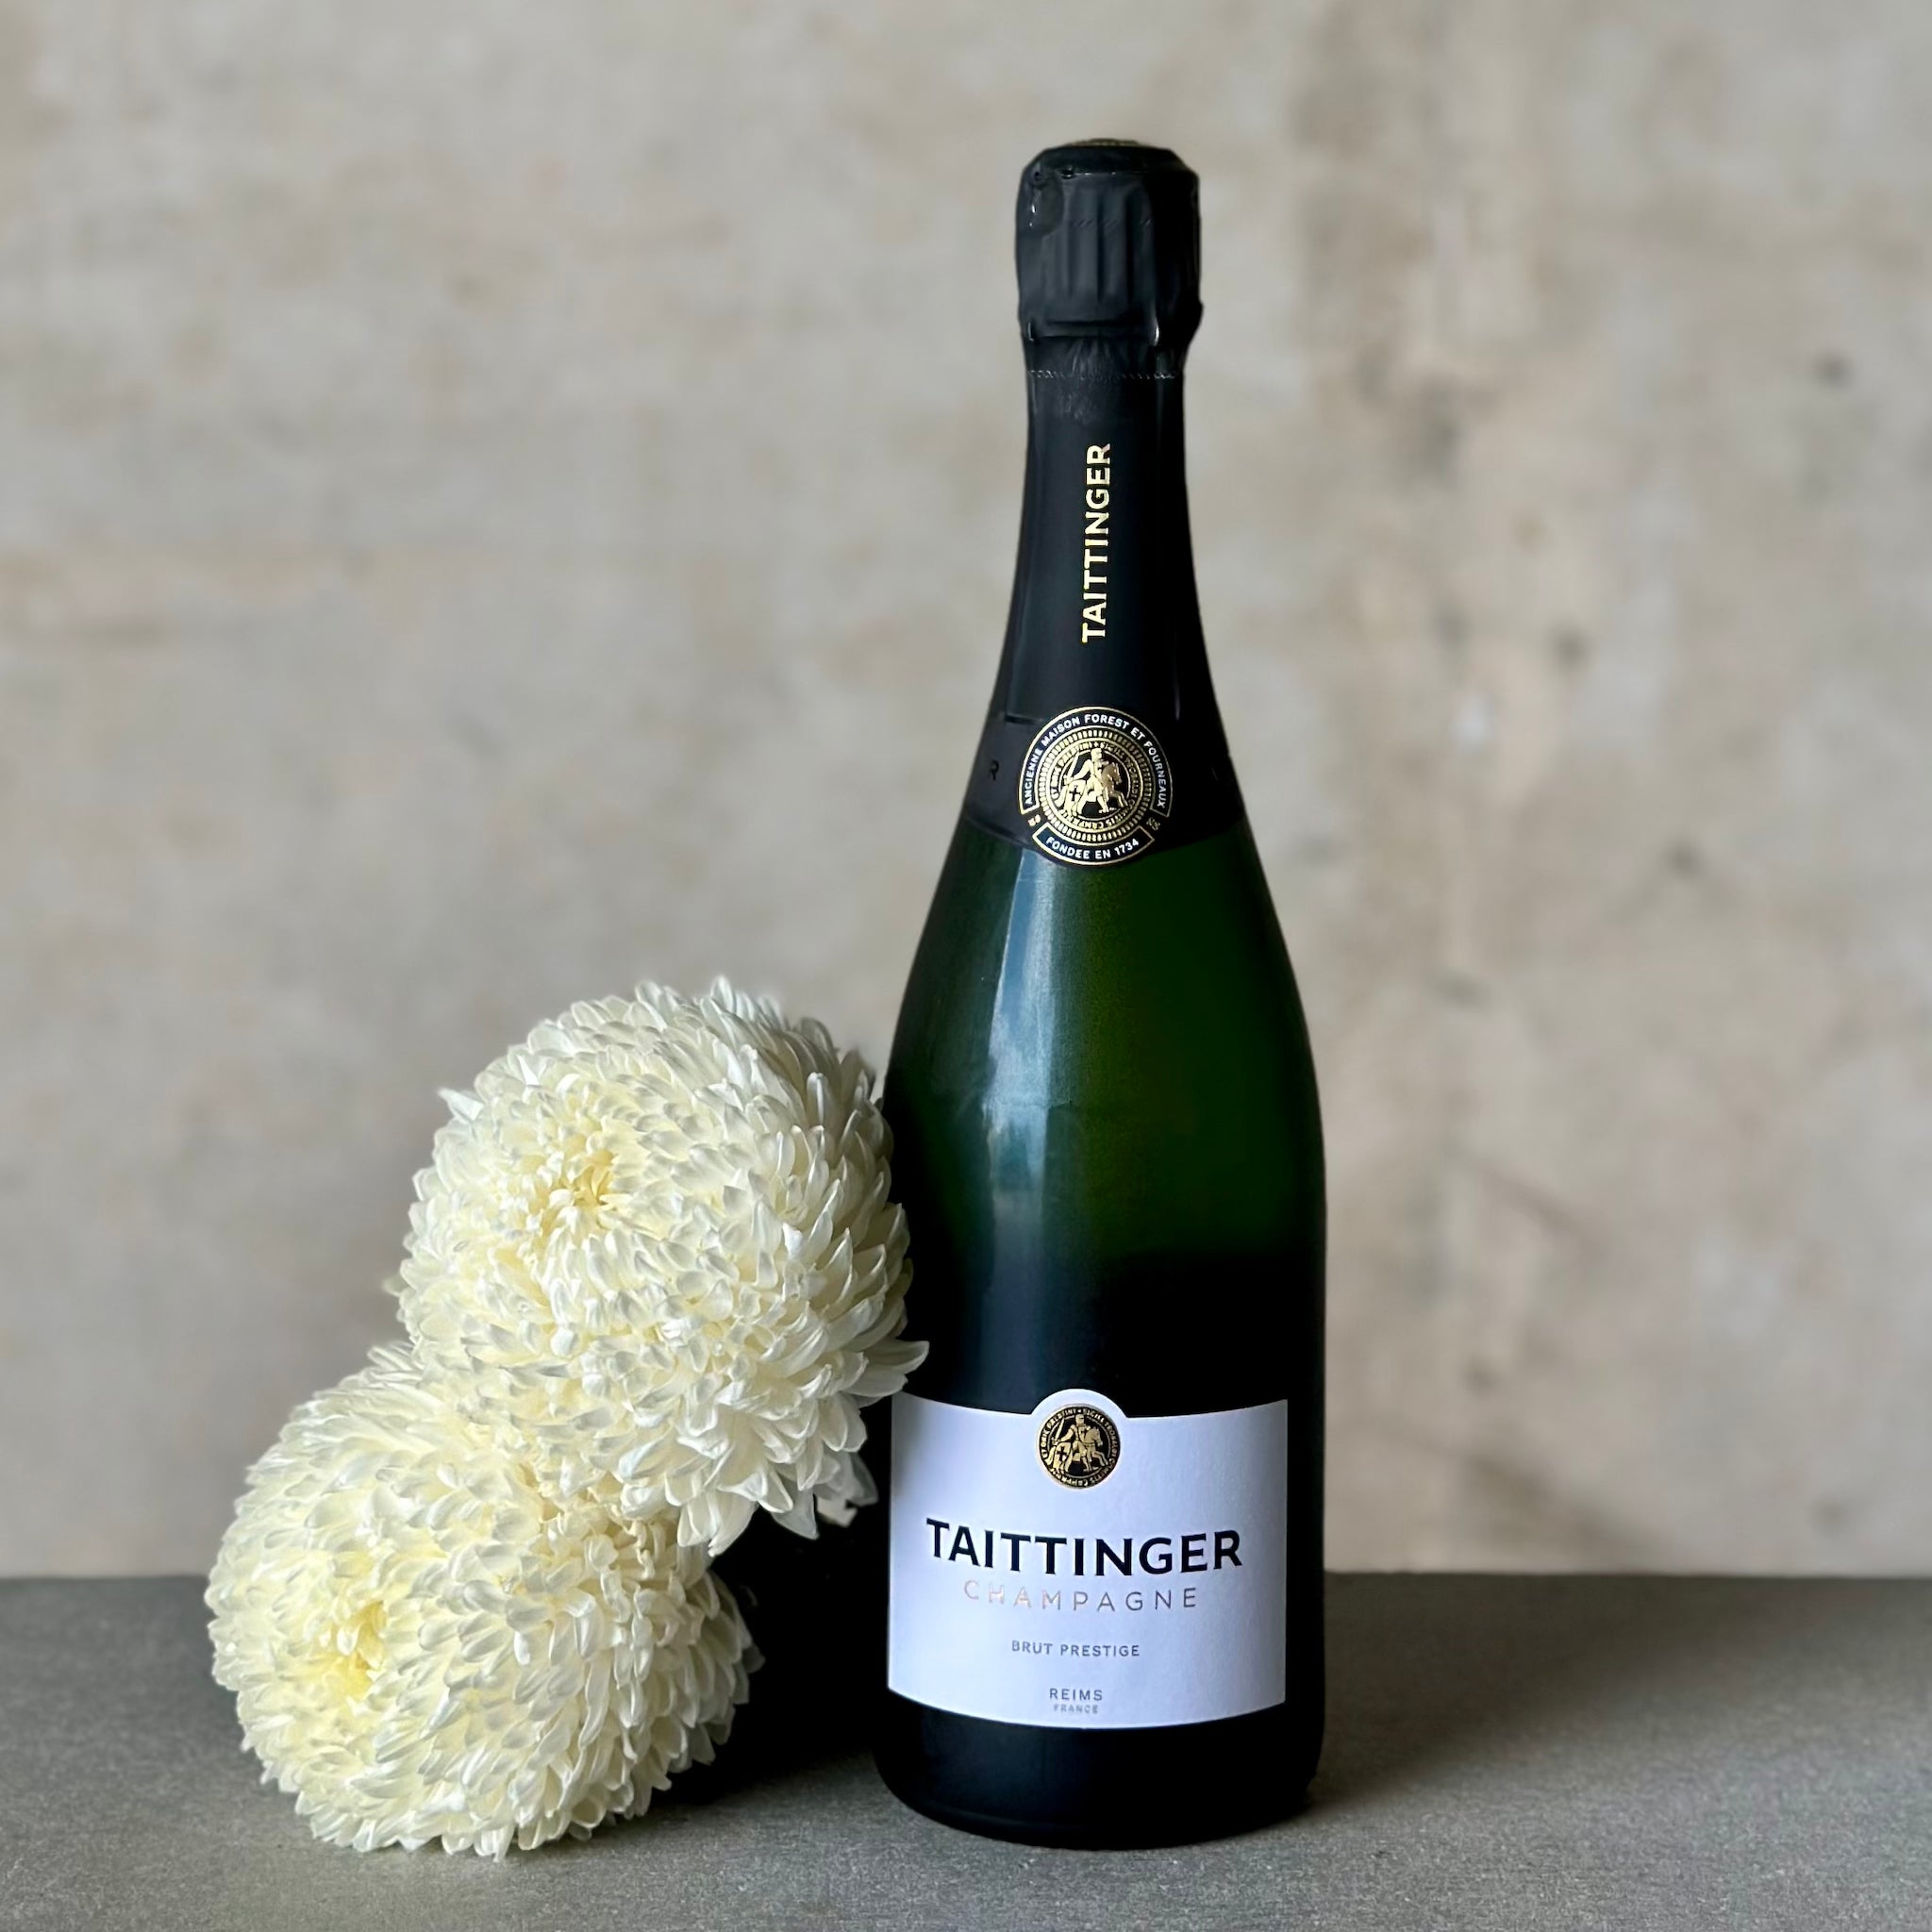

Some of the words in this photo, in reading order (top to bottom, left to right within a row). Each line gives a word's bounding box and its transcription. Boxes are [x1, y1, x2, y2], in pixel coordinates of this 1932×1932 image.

[1082, 443, 1110, 642] TAITTINGER
[1024, 749, 1043, 804] ANCIENNE
[1041, 717, 1080, 745] MAISON
[1085, 714, 1130, 729] FOREST
[1131, 727, 1146, 741] ET
[1143, 741, 1167, 808] FOURNEAUX
[1046, 836, 1090, 859] FONDEE
[1095, 849, 1111, 859] EN
[1114, 838, 1139, 856] 1734
[926, 1518, 1242, 1575] TAITTINGER
[964, 1579, 1196, 1611] CHAMPAGNE
[1012, 1640, 1053, 1655] BRUT
[1060, 1644, 1140, 1657] PRESTIGE
[1049, 1688, 1103, 1701] REIMS
[1054, 1703, 1099, 1713] FRANCE
